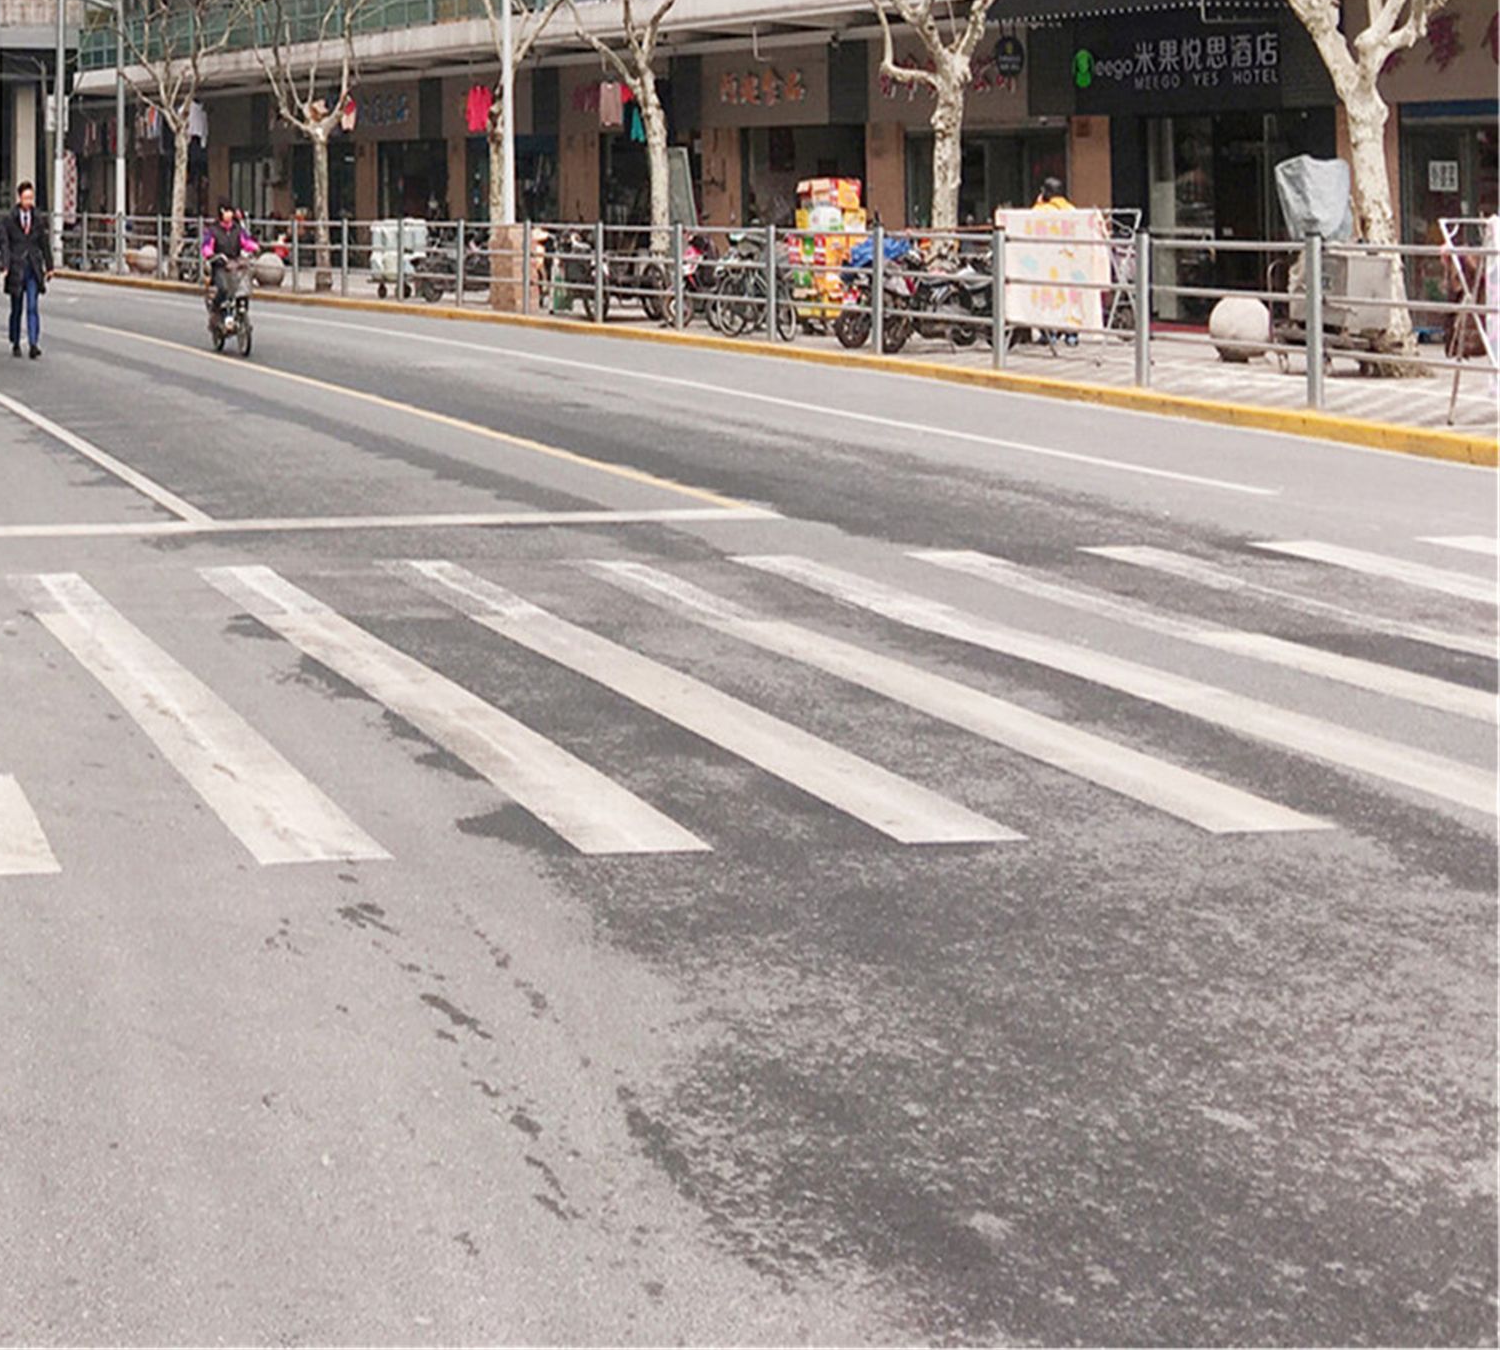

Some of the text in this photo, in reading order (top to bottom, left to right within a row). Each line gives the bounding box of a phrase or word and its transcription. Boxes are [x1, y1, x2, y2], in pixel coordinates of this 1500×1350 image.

[1134, 32, 1279, 74] 米果悦思酒店
[1134, 68, 1279, 90] MEEGO YES HOTEL
